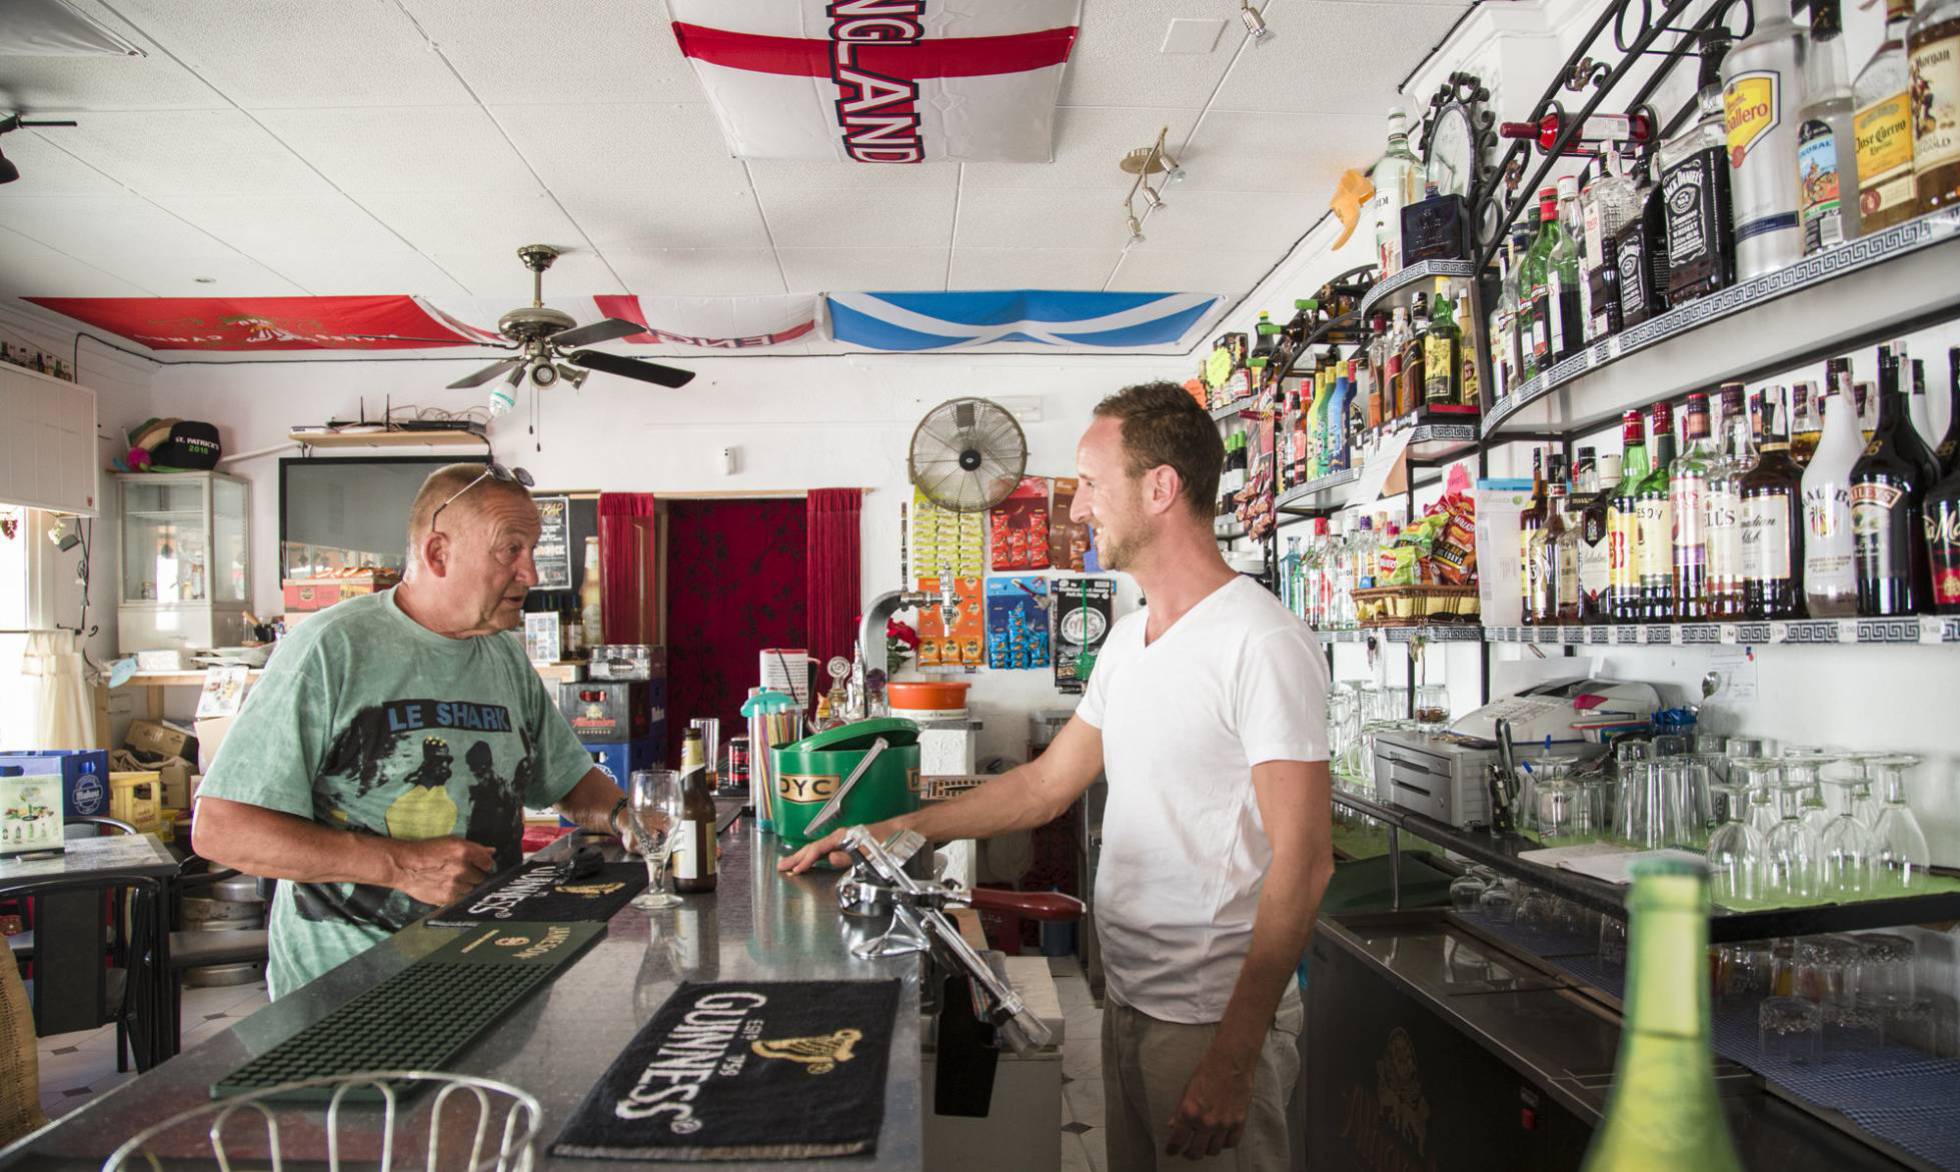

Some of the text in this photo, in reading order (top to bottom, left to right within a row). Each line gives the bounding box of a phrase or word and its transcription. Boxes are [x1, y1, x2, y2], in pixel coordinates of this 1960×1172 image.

[387, 703, 511, 732] LE SHARK
[615, 991, 768, 1121] GUINNESS
